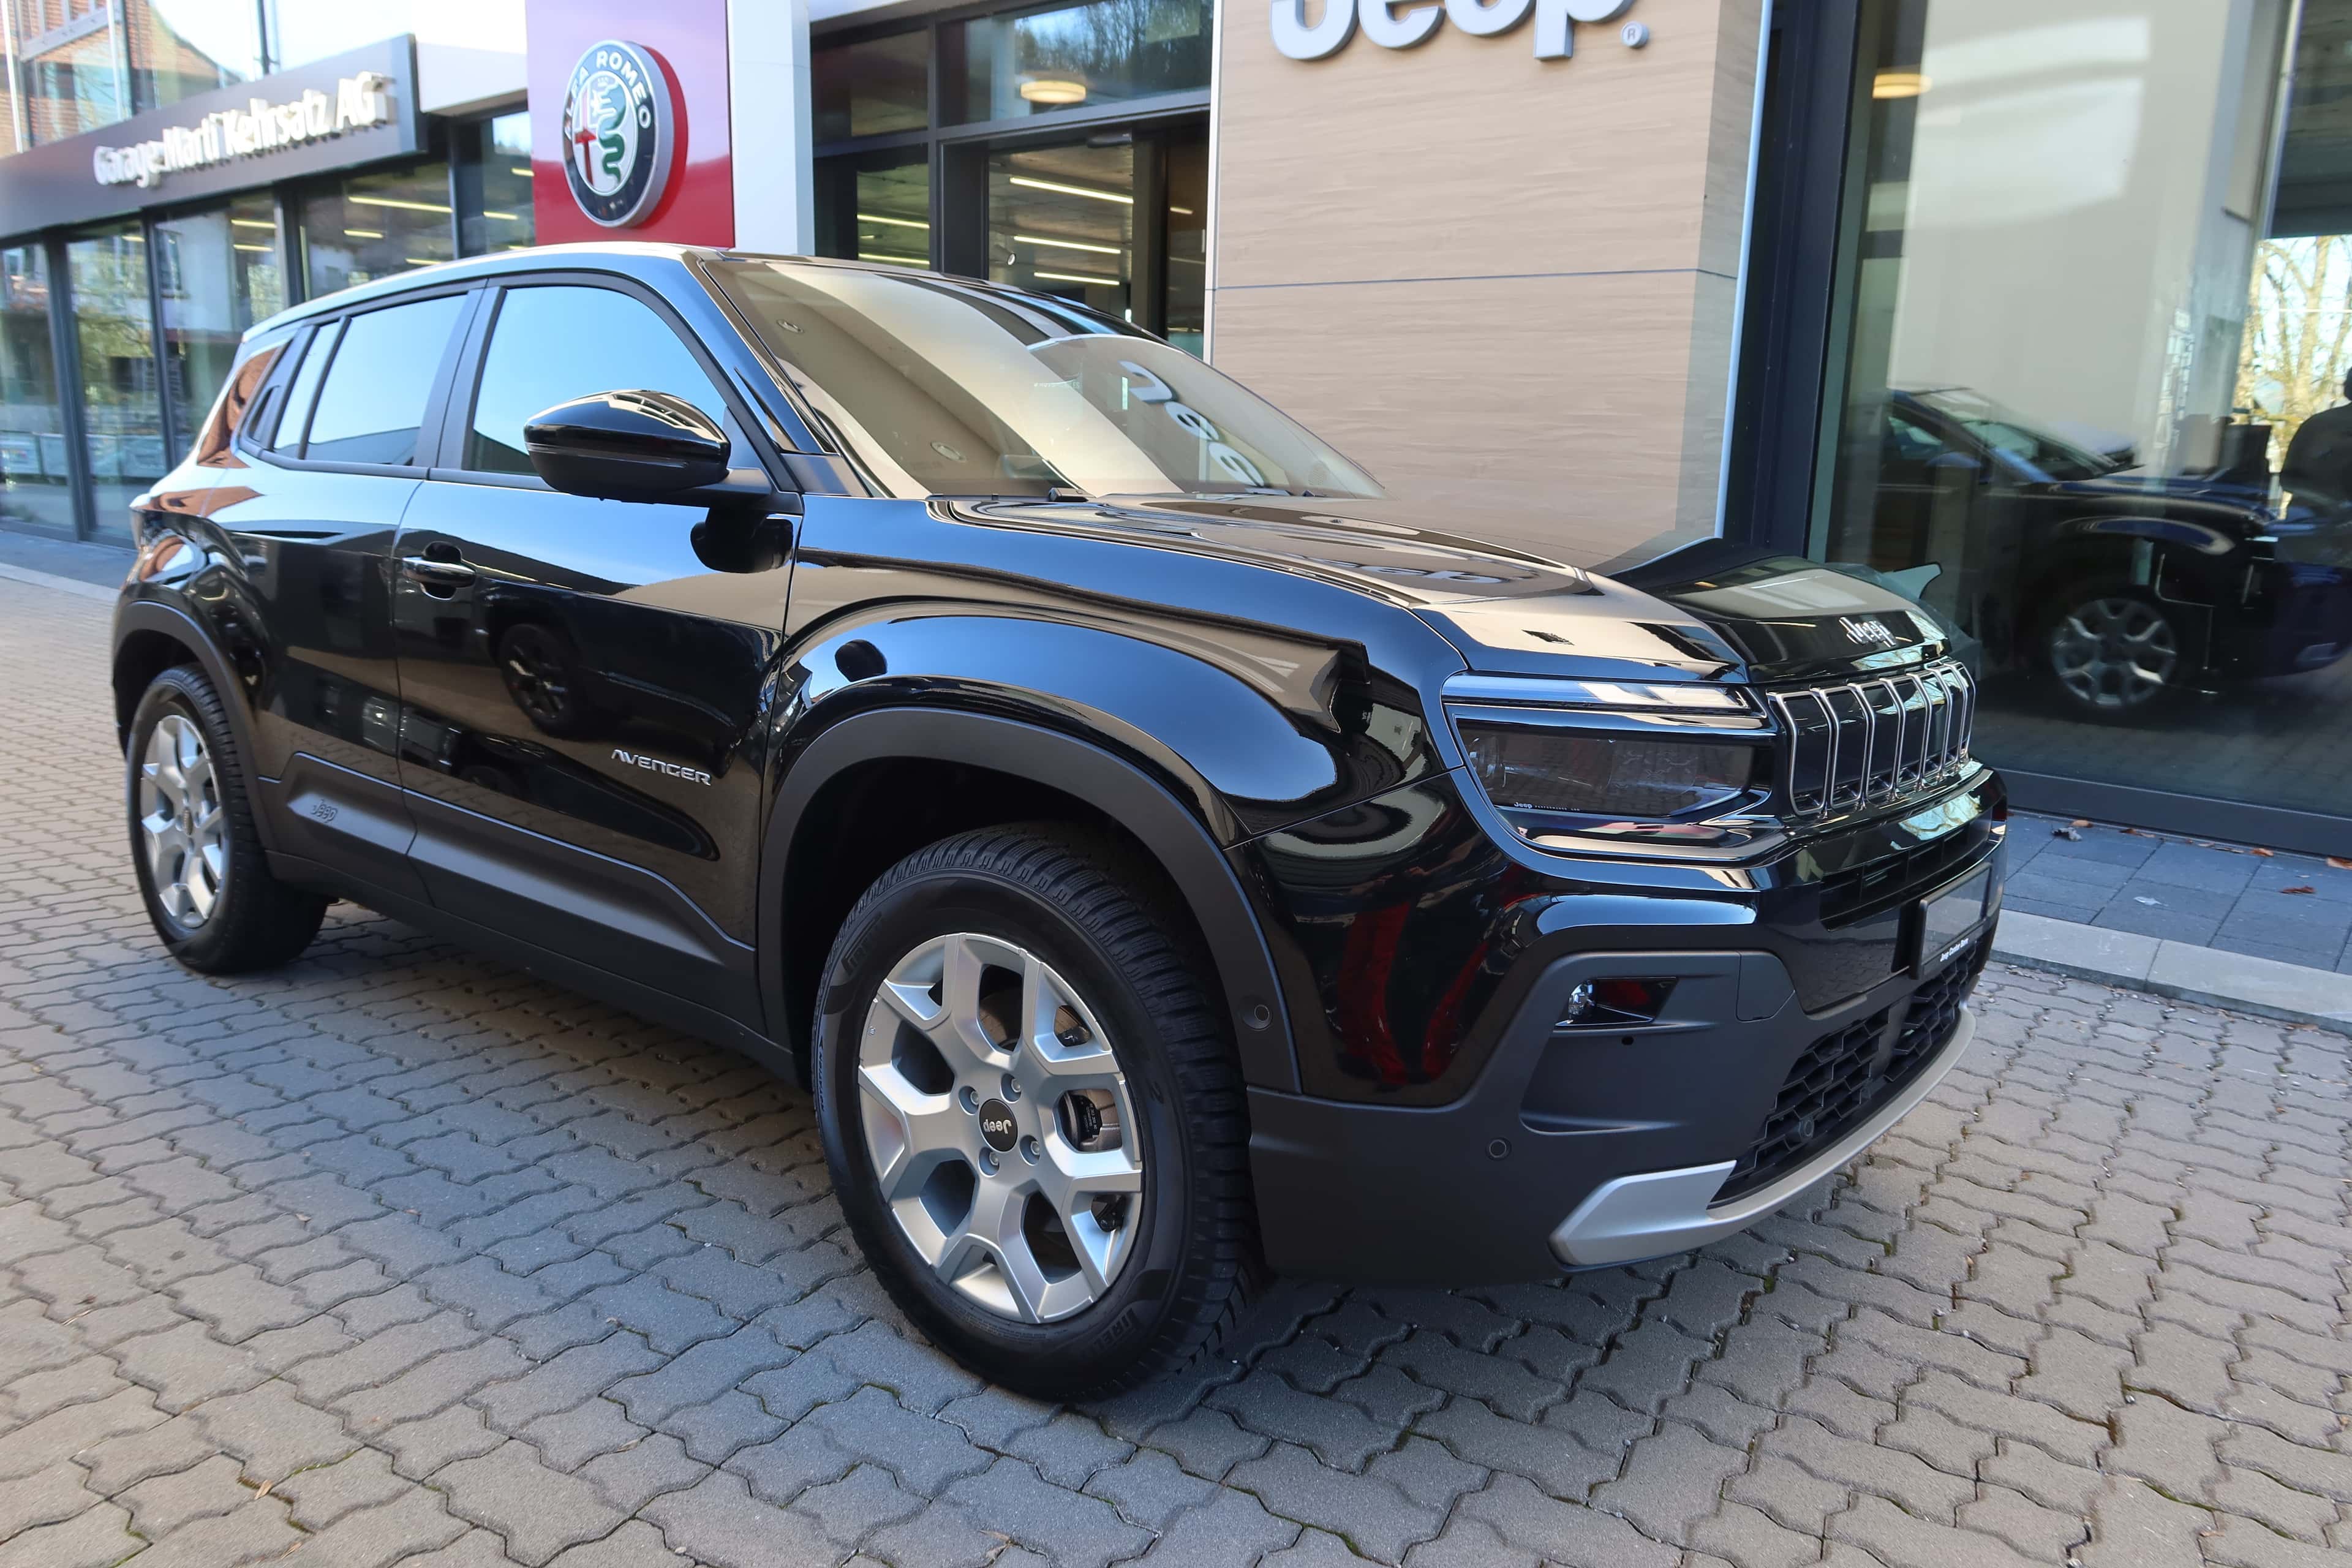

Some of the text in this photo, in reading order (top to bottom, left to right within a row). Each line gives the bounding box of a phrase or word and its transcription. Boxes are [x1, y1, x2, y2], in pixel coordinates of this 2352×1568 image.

[565, 50, 652, 141] ALFA ROMEO
[93, 70, 387, 189] Garage Marti Kehrsatz AG
[1838, 616, 1897, 647] Jeep
[611, 748, 712, 786] AVENGER
[311, 798, 338, 823] Jeep
[982, 1118, 1012, 1134] Jeep
